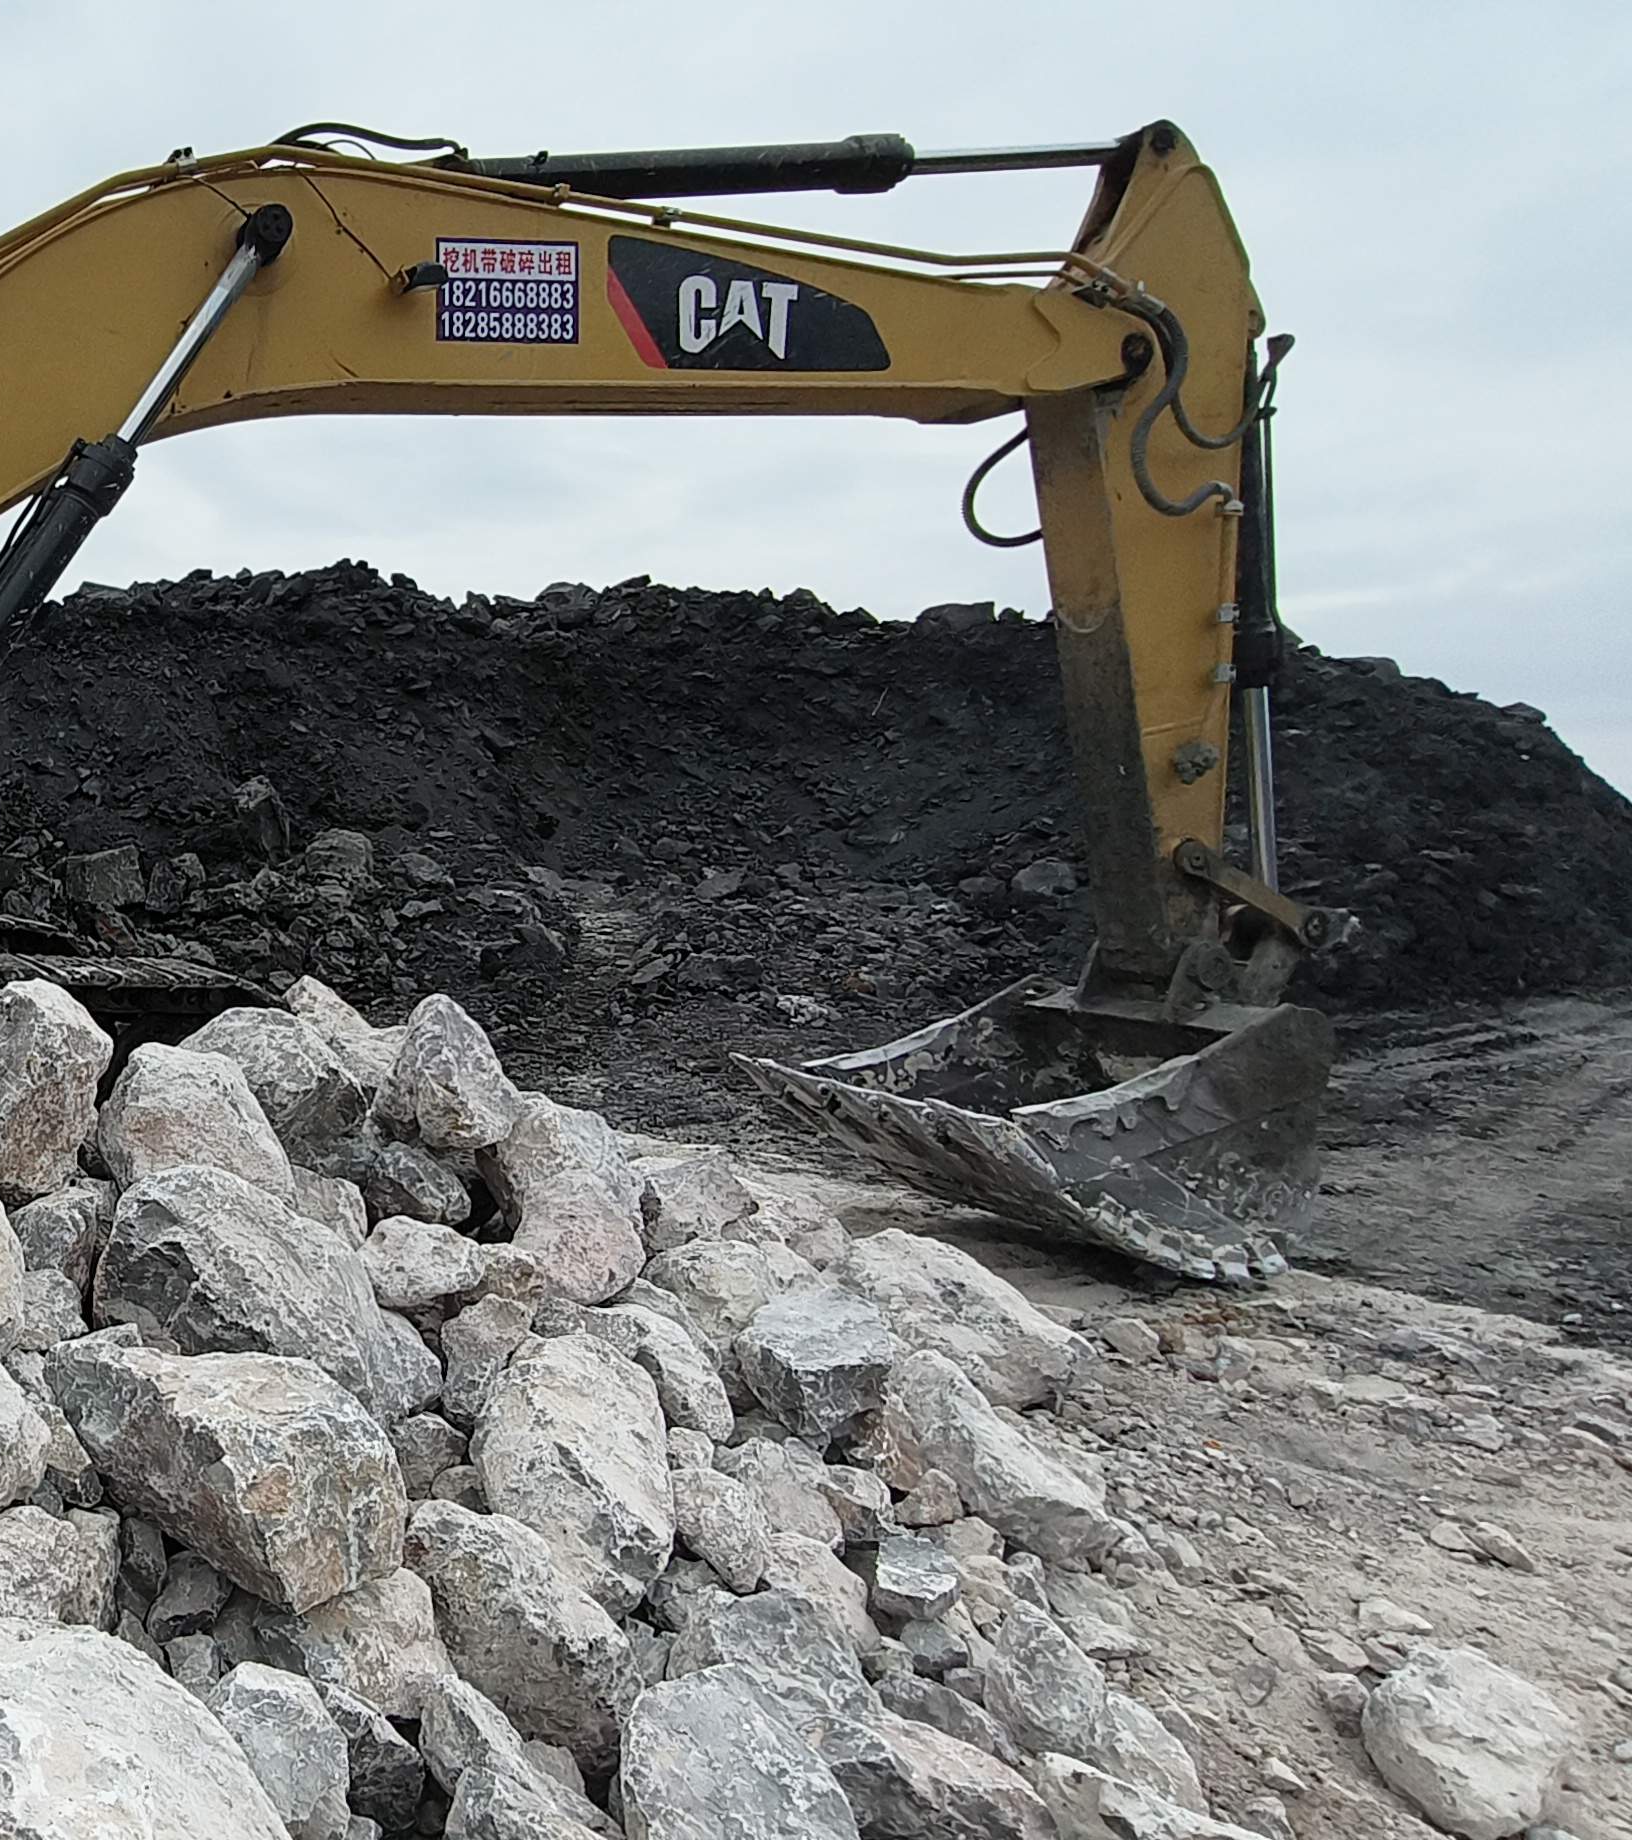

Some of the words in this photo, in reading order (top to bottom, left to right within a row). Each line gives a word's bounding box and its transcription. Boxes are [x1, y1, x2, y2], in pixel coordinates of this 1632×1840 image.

[443, 247, 572, 275] 挖机带破碎出租
[441, 281, 574, 309] 18216668883
[441, 311, 574, 340] 18285888383
[678, 275, 799, 360] CAT
